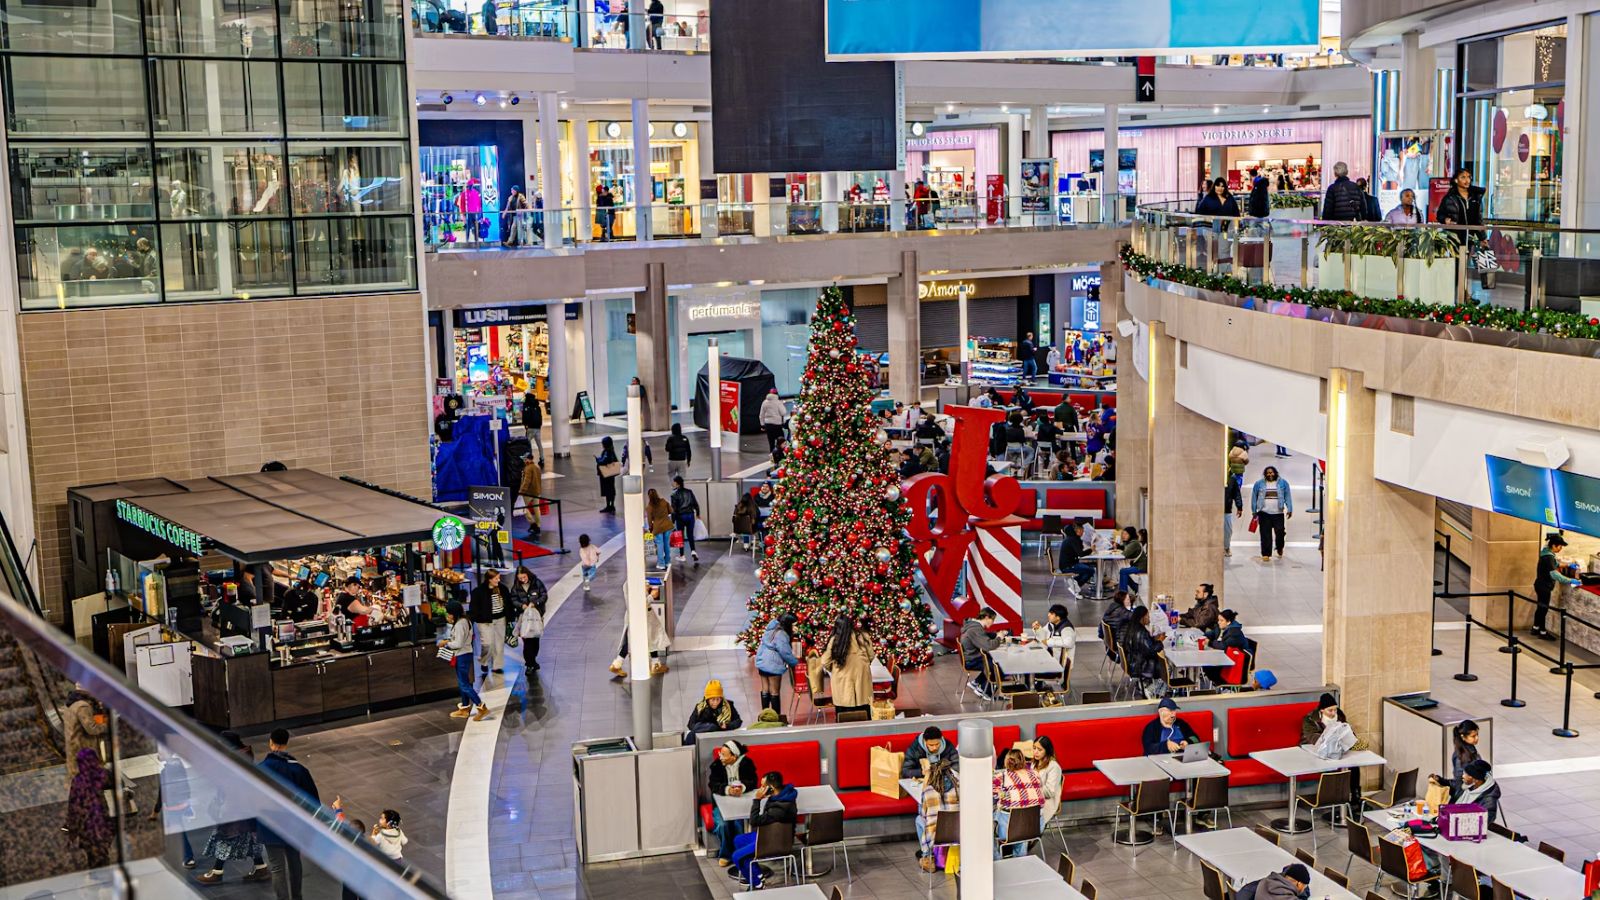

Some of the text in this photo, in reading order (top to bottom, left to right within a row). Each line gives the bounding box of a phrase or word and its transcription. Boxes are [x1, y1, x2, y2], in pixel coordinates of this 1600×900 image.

[1202, 128, 1293, 140] VICTORIA'S SECRET
[945, 136, 971, 145] SECRET
[464, 309, 509, 323] LUSH
[689, 303, 752, 320] perfumania
[473, 492, 503, 500] SIMON
[1505, 485, 1531, 497] SIMON
[116, 499, 203, 557] STARBUCKS COFFEE
